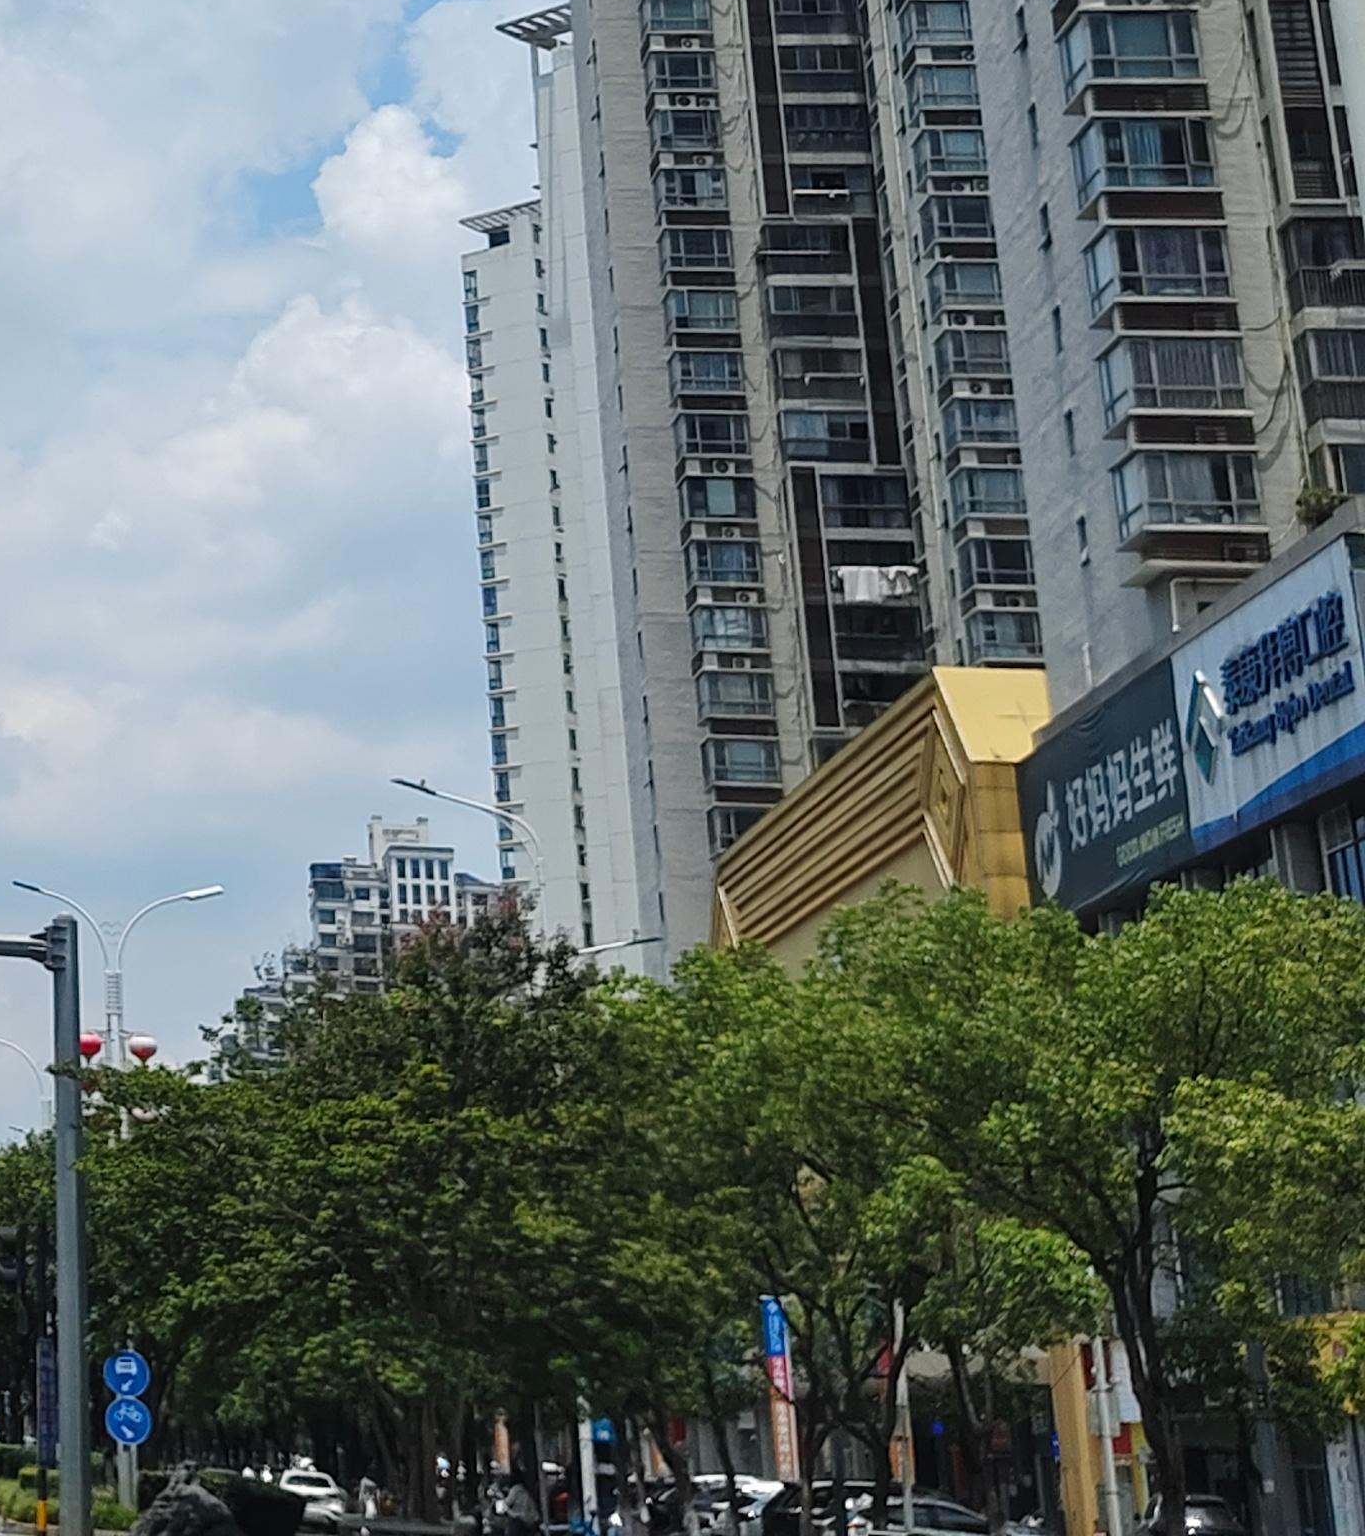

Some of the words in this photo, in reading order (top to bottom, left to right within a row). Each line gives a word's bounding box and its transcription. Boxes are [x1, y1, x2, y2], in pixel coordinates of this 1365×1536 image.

[1065, 717, 1178, 853] 好妈妈生鲜
